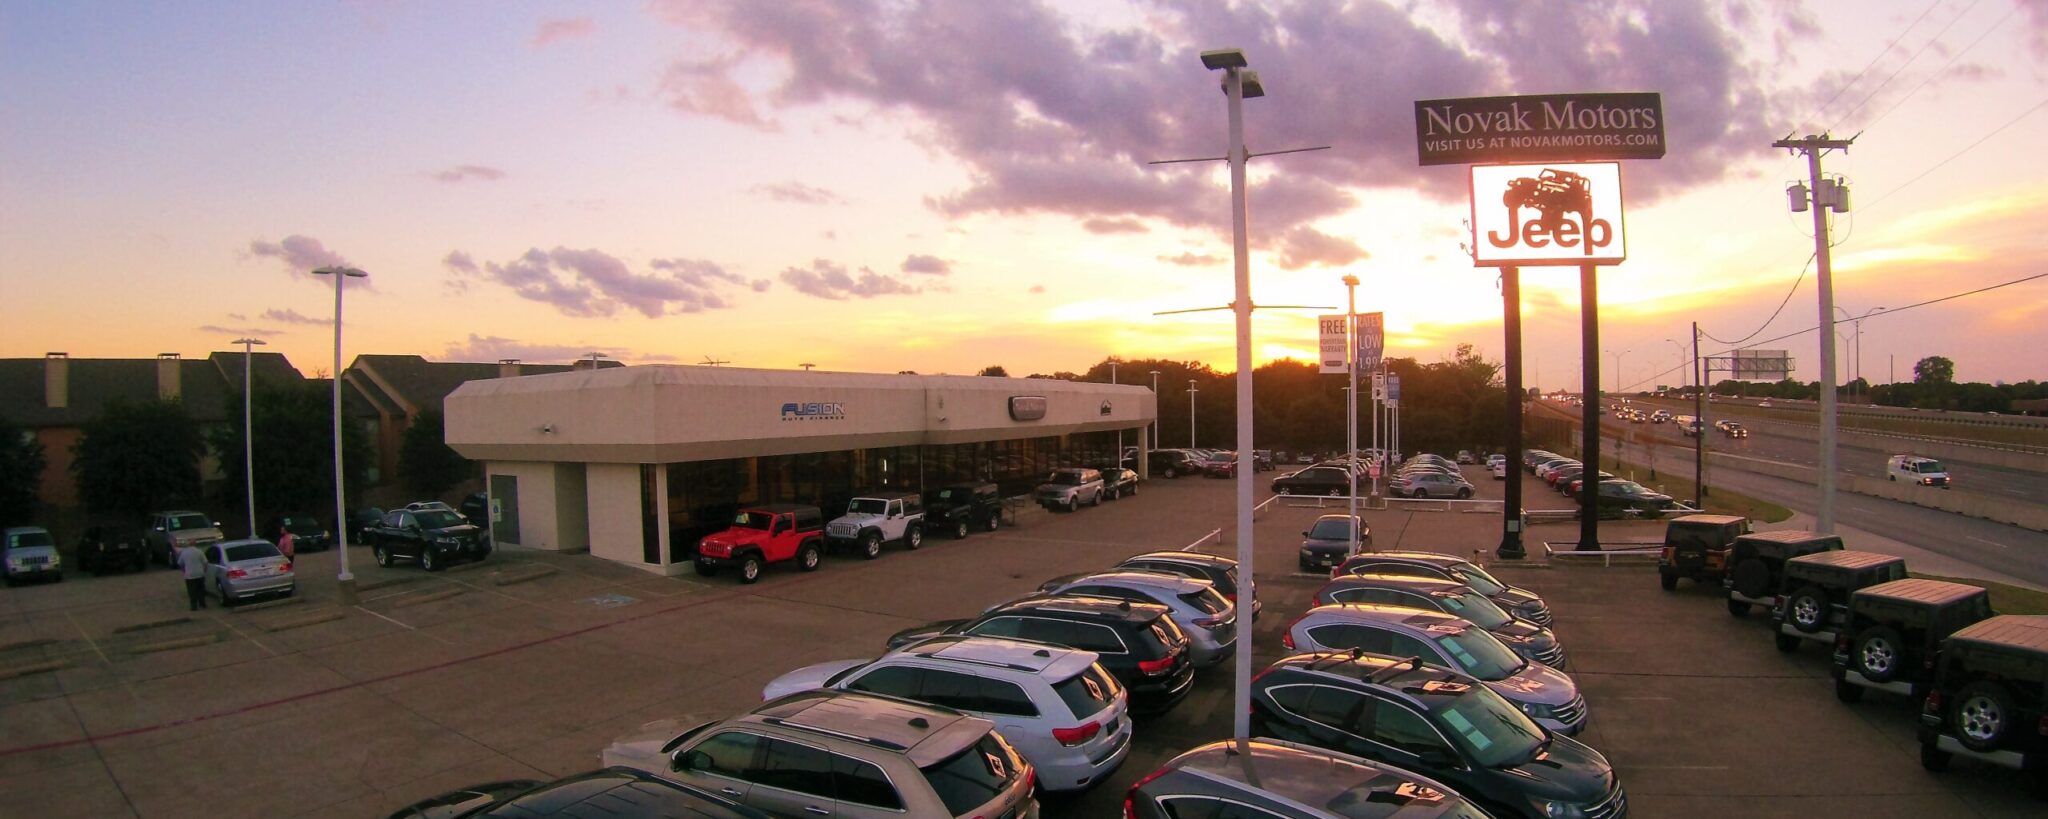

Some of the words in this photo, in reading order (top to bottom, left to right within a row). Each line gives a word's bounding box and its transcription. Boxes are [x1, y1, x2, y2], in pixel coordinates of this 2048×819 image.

[1423, 102, 1534, 136] Novak
[1540, 100, 1657, 130] Motors
[1425, 140, 1462, 152] VISIT
[1466, 138, 1486, 150] US
[1489, 137, 1506, 149] AT
[1511, 134, 1659, 149] NOVAKMOTORS.COM
[1487, 205, 1613, 256] Jeep
[1320, 319, 1346, 334] FREE
[1359, 334, 1382, 350] LOW
[781, 402, 845, 416] FUSION
